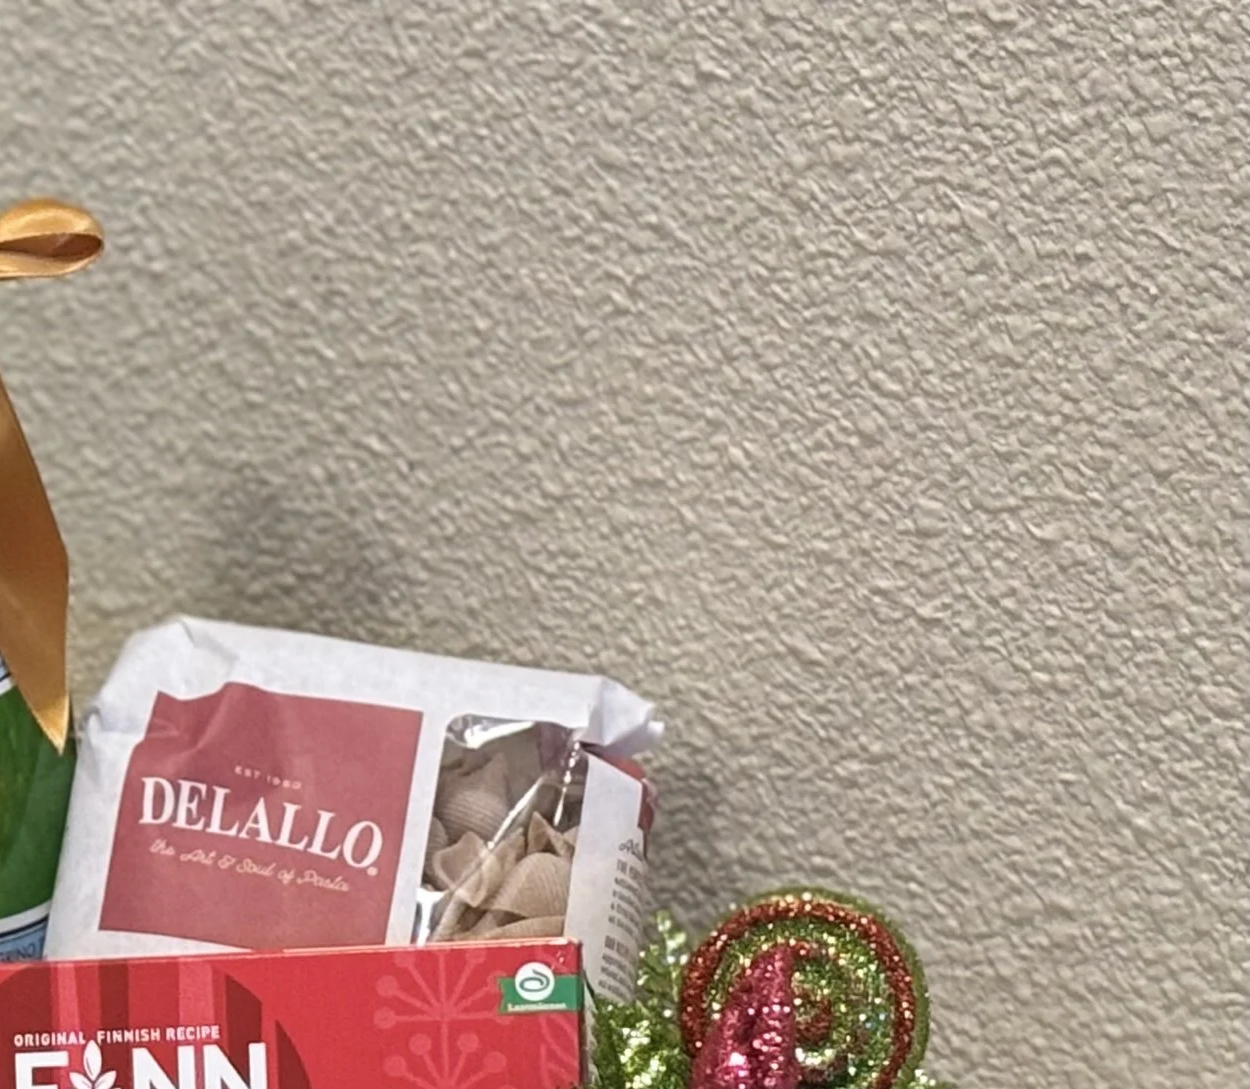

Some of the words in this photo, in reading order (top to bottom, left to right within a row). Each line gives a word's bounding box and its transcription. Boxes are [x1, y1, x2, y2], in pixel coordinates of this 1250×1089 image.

[138, 776, 384, 870] DELALLO
[149, 838, 176, 856] the
[277, 867, 295, 885] of
[296, 869, 350, 893] Pasta
[13, 1030, 87, 1048] ORIGINAL
[96, 1027, 162, 1045] FINNISH
[166, 1025, 221, 1042] RECIPE
